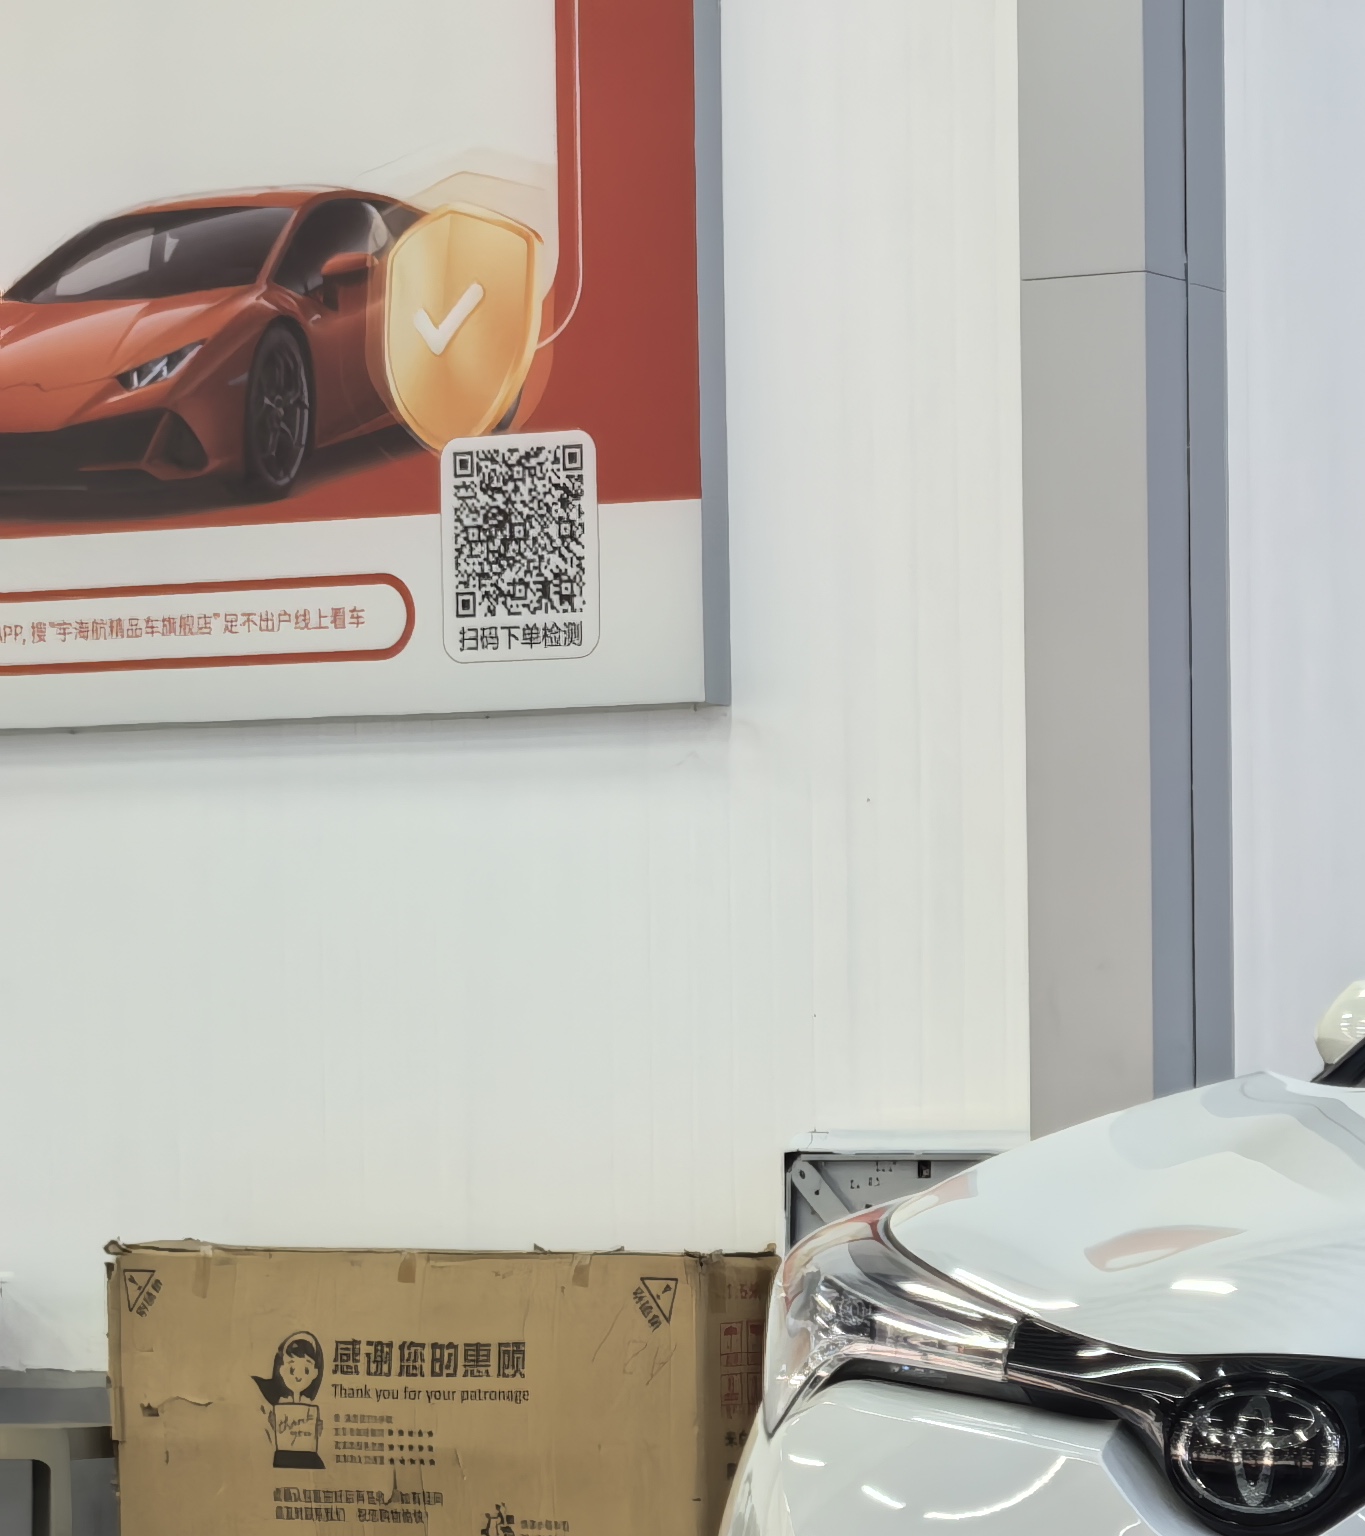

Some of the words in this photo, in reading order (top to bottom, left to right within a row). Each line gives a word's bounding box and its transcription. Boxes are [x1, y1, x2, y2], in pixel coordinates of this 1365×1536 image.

[459, 620, 583, 652] 扫码下单检测
[331, 1338, 526, 1379] 感谢您的惠顾
[331, 1383, 372, 1400] Thank
[375, 1387, 399, 1403] you
[403, 1385, 422, 1400] for
[425, 1388, 457, 1404] your
[460, 1387, 530, 1405] patronage
